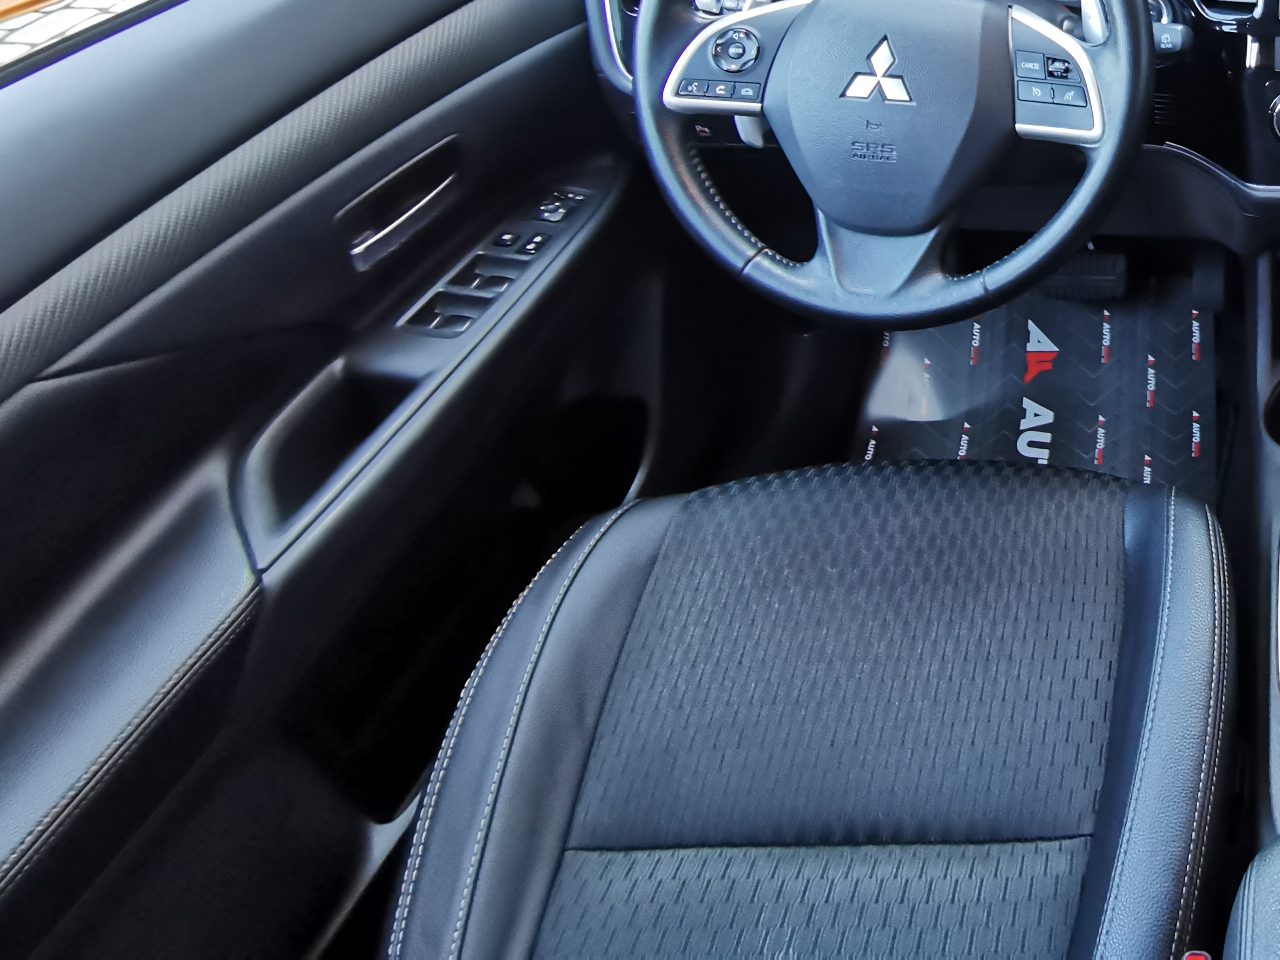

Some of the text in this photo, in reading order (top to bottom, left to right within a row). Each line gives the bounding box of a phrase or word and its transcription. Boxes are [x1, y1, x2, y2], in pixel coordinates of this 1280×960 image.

[1021, 61, 1040, 70] CANCEL
[972, 322, 981, 347] AUTO
[1102, 323, 1111, 346] AUTO
[1192, 320, 1200, 343] AUTO
[1147, 368, 1156, 390] AUTO
[1097, 427, 1106, 448] AUTO
[1192, 422, 1200, 443] AUTO
[864, 439, 877, 460] AUTO
[958, 434, 969, 456] AUTO
